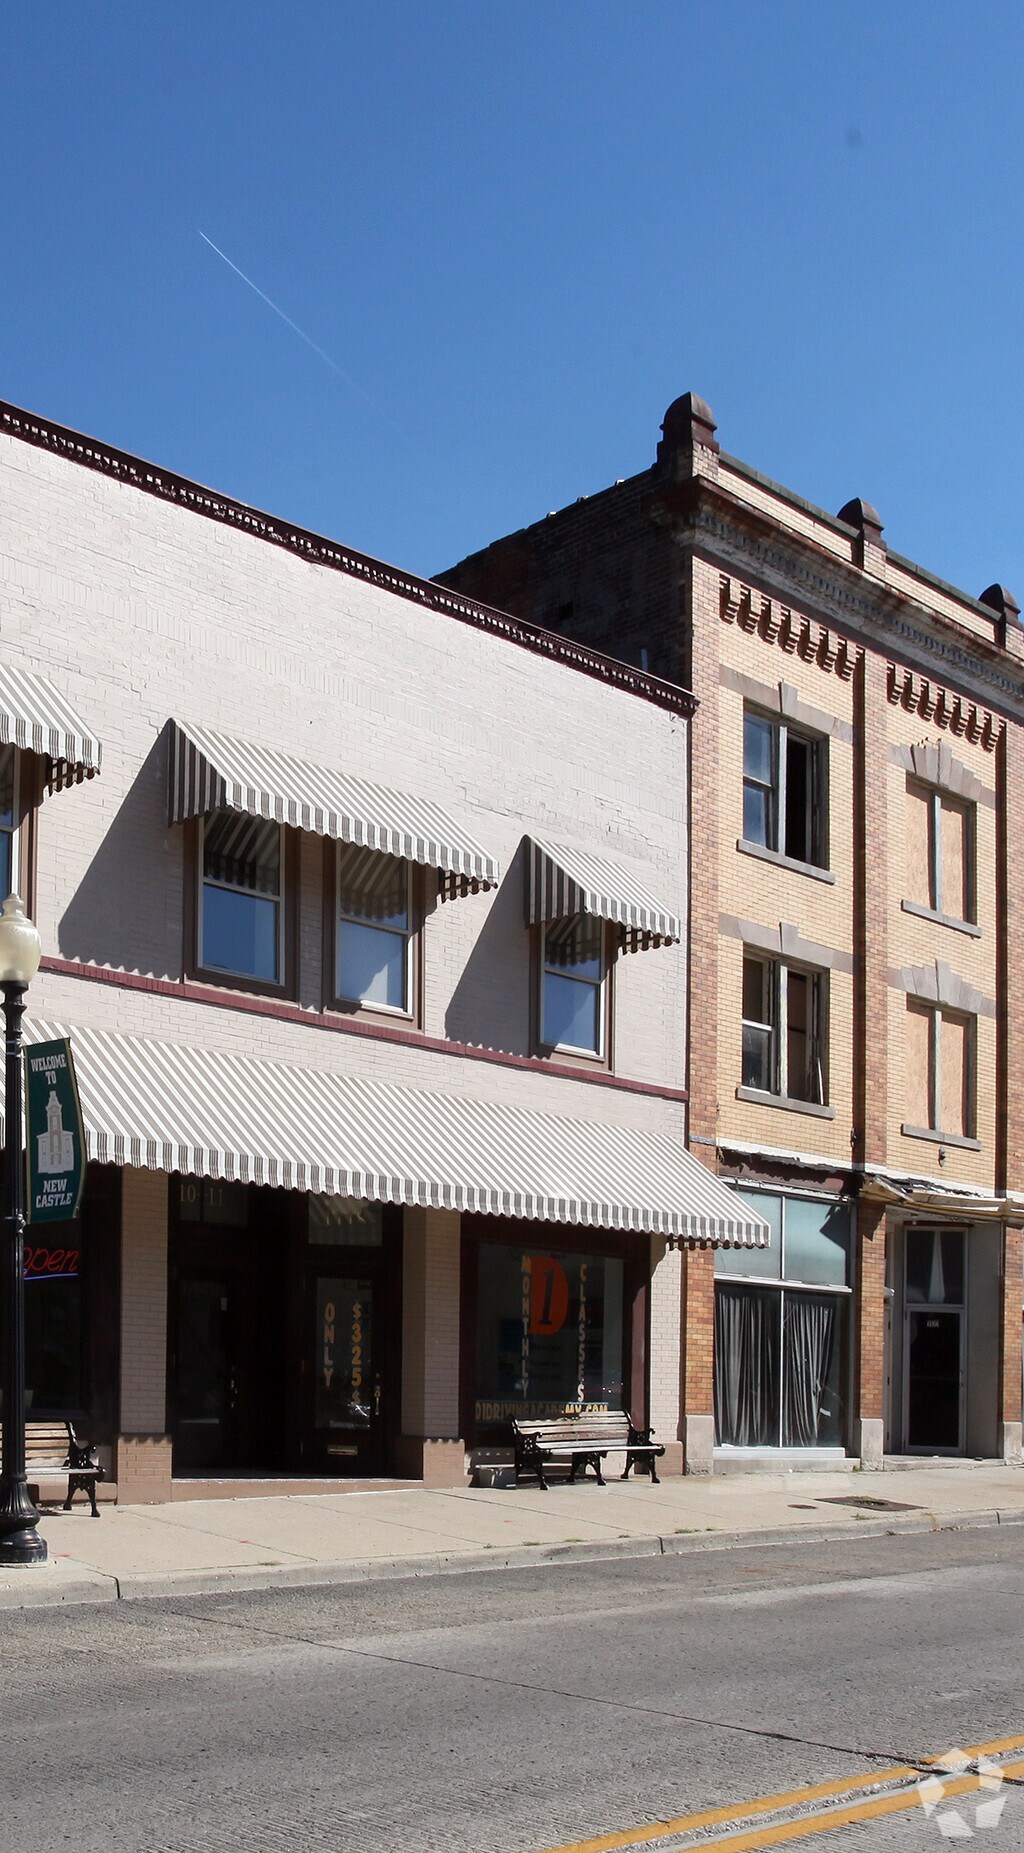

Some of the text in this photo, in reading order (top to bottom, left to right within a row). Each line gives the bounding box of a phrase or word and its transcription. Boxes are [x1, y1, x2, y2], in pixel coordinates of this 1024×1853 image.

[31, 1053, 67, 1073] WELCOME
[45, 1071, 57, 1085] TO
[43, 1179, 68, 1193] NEW
[36, 1192, 73, 1208] CASTLE
[521, 1255, 532, 1399] MONTHLY
[577, 1263, 588, 1402] CLASSES
[323, 1302, 336, 1388] ONLY
